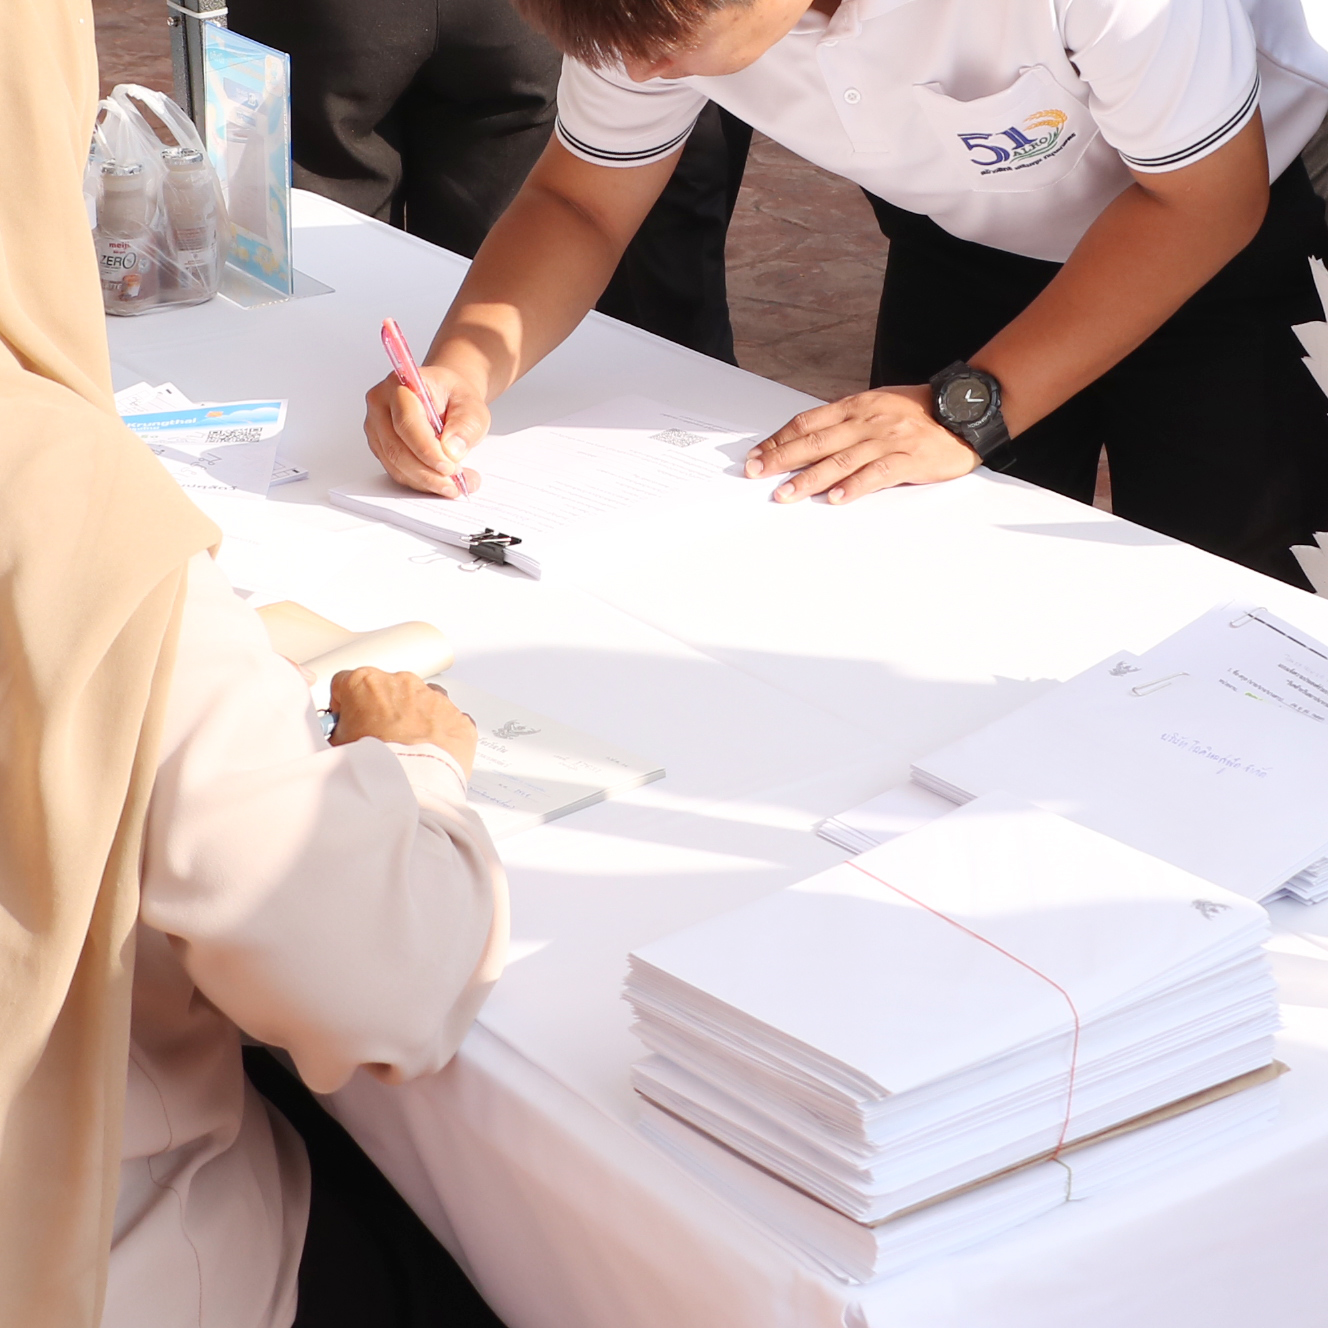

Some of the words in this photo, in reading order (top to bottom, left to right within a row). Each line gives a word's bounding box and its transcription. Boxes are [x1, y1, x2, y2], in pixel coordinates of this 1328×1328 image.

[957, 126, 1039, 166] 51
[1012, 136, 1048, 157] ALRO
[126, 417, 197, 428] Krungthai
